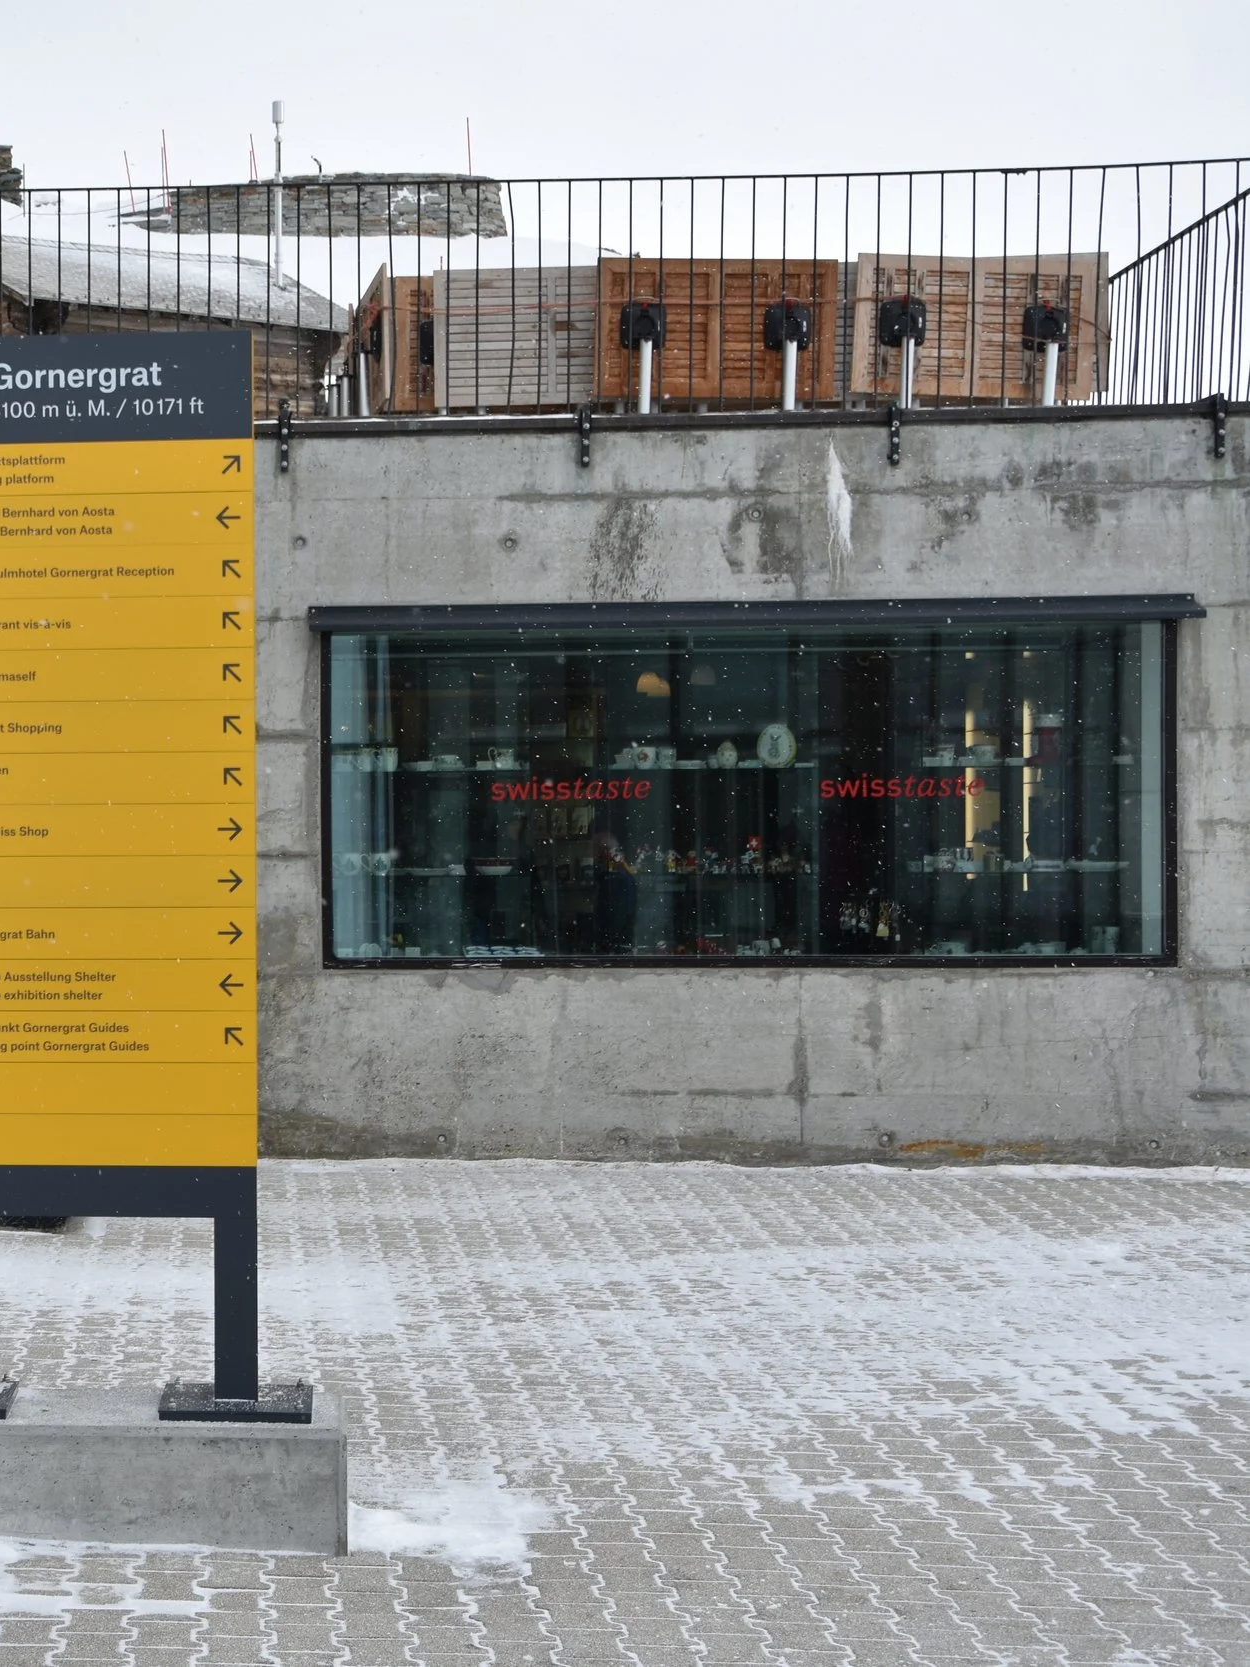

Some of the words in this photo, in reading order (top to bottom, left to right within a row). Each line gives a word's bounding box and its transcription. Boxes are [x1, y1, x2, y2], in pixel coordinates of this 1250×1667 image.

[42, 404, 59, 417] m
[66, 402, 81, 417] ü.
[88, 400, 110, 416] M.
[189, 397, 204, 414] ft
[6, 474, 54, 486] platform
[2, 508, 54, 518] Bernhard
[59, 509, 78, 517] von
[82, 507, 114, 516] Aosta
[0, 526, 53, 536] Bernhard
[57, 527, 76, 535] von
[80, 526, 112, 535] Aosta
[50, 566, 114, 581] Gornergrat
[117, 566, 174, 580] Reception
[7, 722, 62, 734] Shopping
[491, 776, 651, 801] swisstaste
[820, 773, 986, 798] swisstaste
[20, 826, 48, 838] Shop
[26, 929, 55, 939] Bahn
[4, 972, 71, 984] Ausstellung
[75, 972, 116, 982] Shelter
[4, 990, 60, 1000] exhibition
[63, 990, 102, 1000] shelter
[23, 1022, 85, 1034] Gornergrat
[88, 1022, 129, 1033] Guides
[11, 1041, 39, 1053] point
[43, 1041, 106, 1052] Gornergrat
[109, 1040, 149, 1051] Guides
